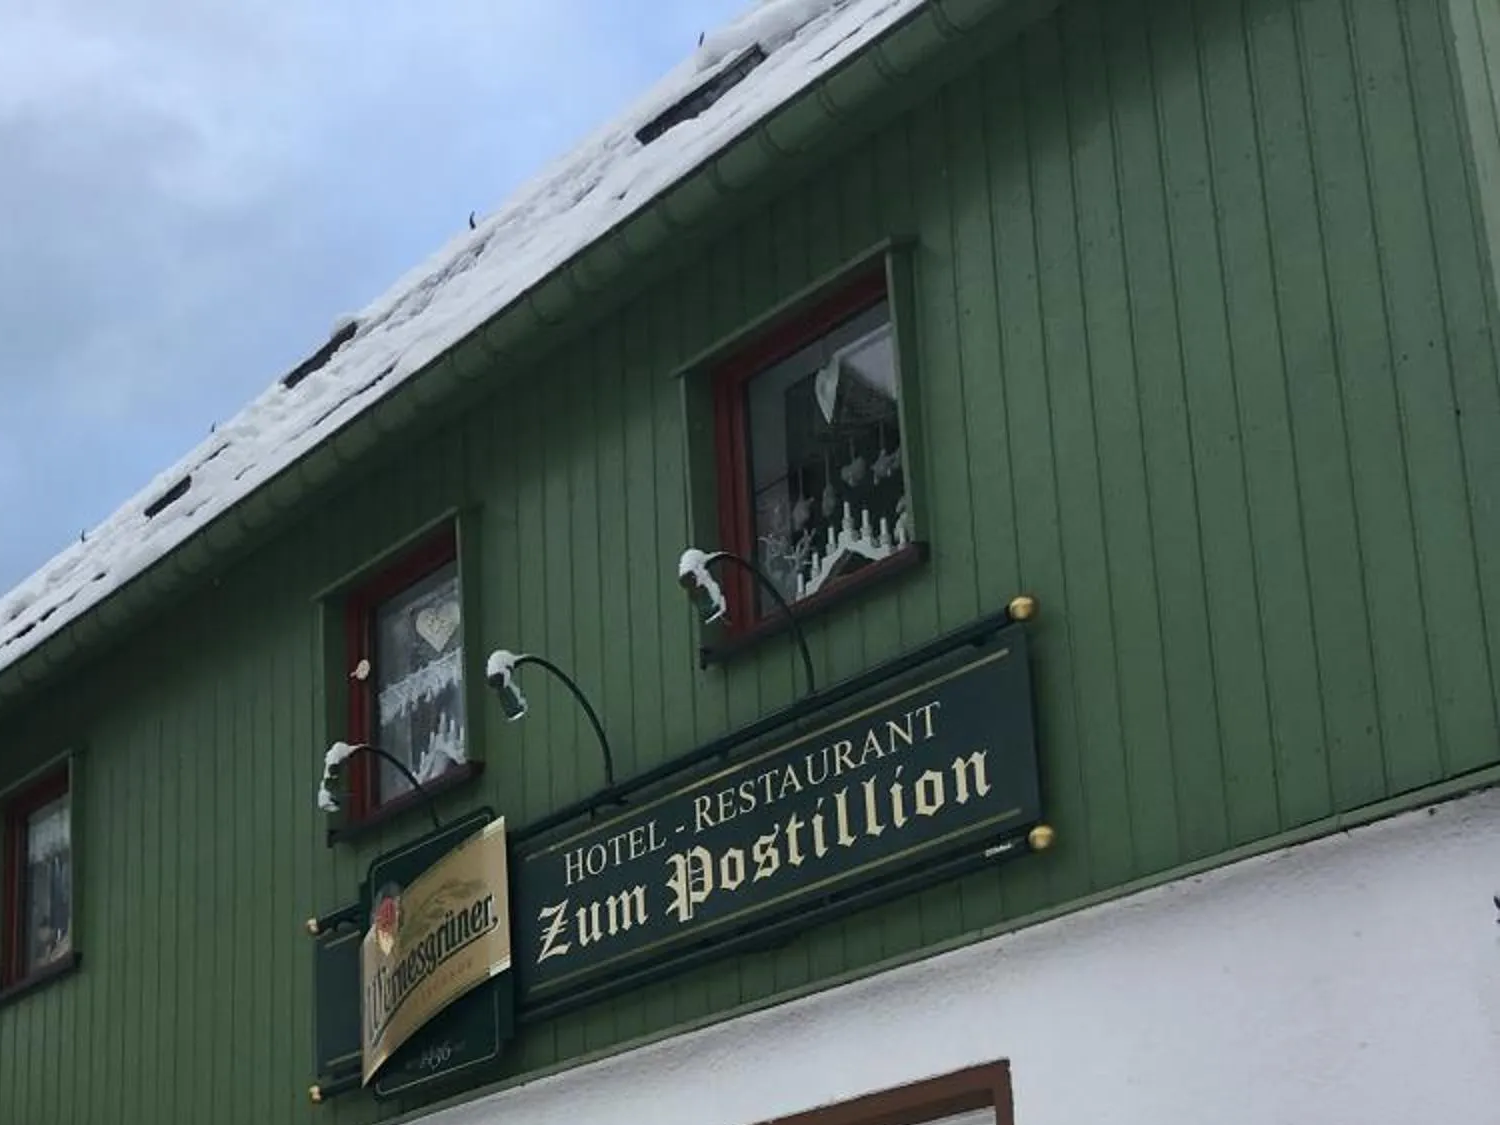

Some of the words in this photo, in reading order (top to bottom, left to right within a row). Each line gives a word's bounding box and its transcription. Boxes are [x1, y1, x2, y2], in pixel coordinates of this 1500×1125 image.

[536, 885, 649, 964] Zum
[665, 749, 992, 923] Postillion
[564, 821, 667, 887] HOTEL
[693, 701, 941, 833] RESTAURANT
